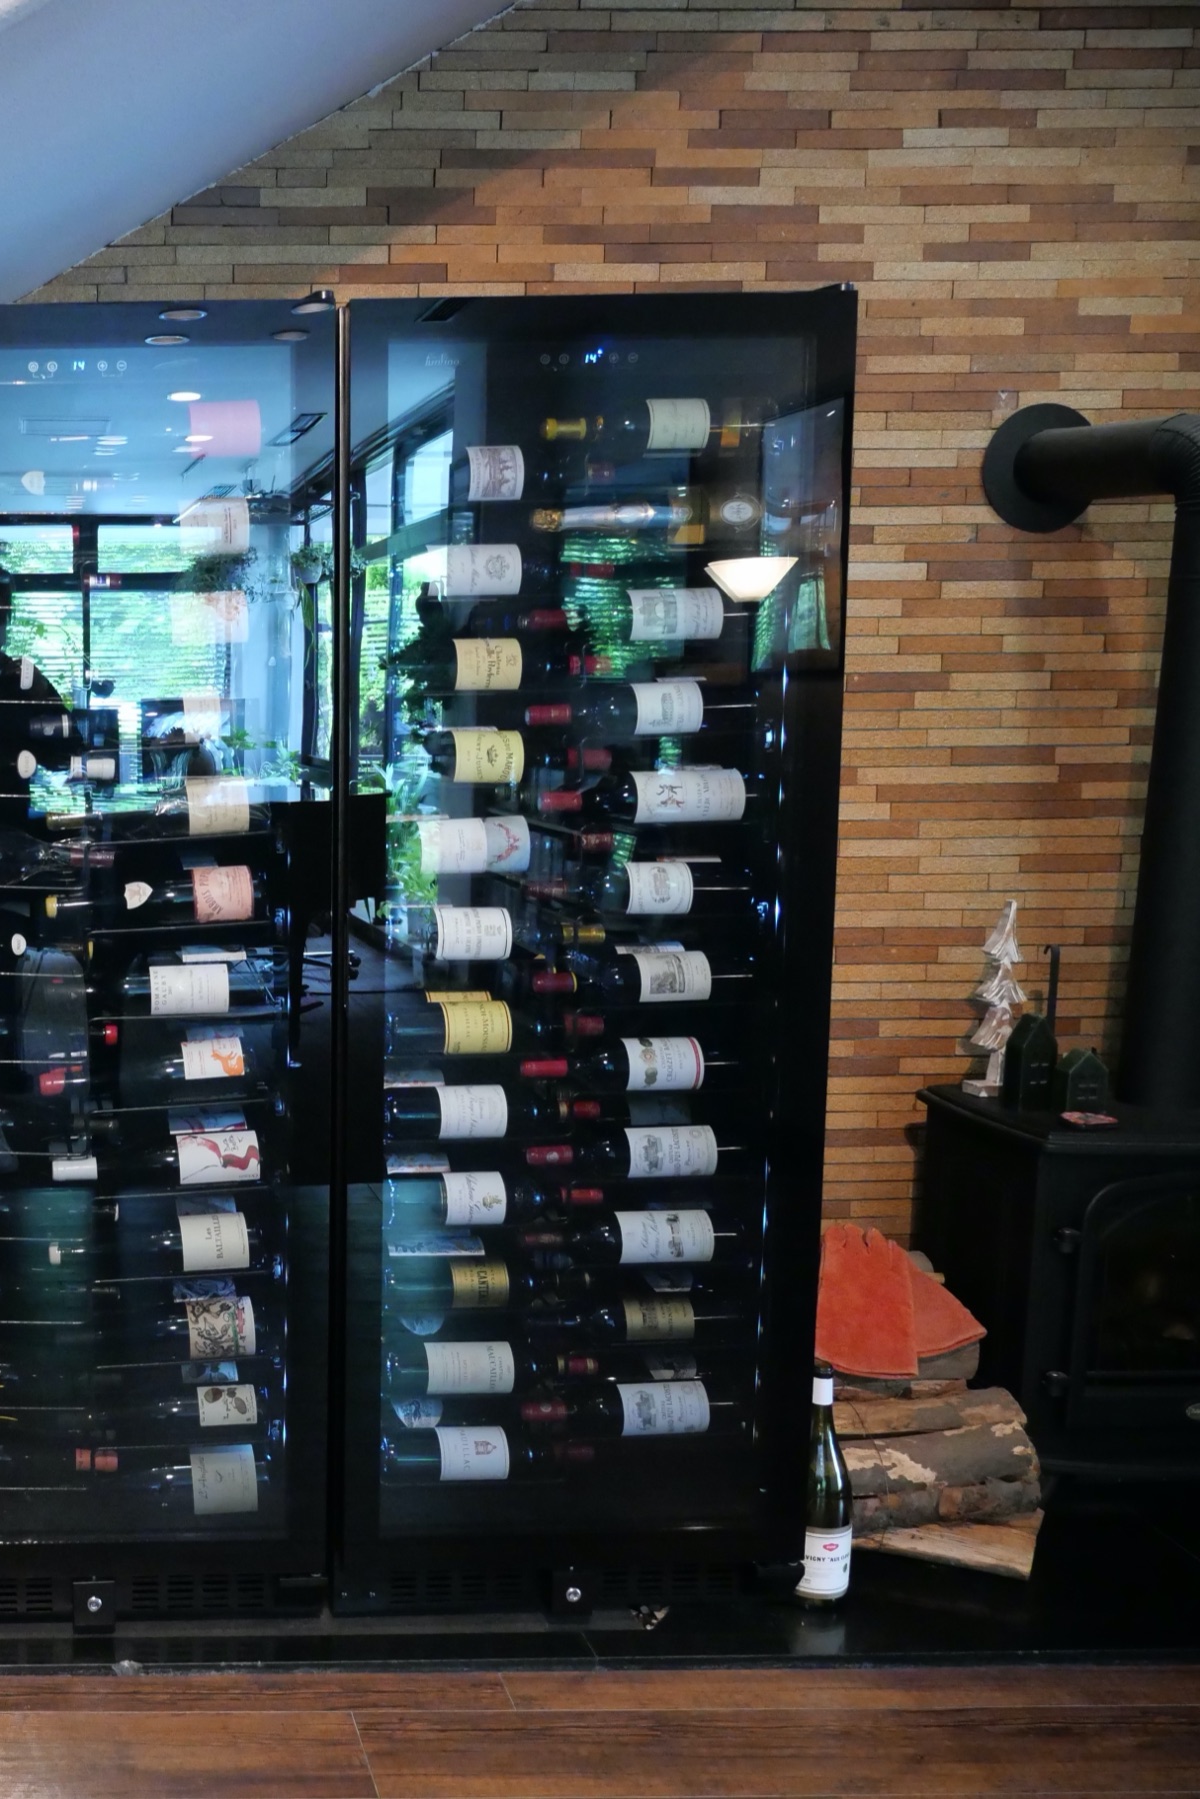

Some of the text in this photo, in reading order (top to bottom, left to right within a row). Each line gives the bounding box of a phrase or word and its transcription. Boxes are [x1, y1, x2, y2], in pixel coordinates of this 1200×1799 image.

[584, 354, 597, 364] 14
[73, 361, 85, 371] 14
[805, 1554, 826, 1562] VIGNY
